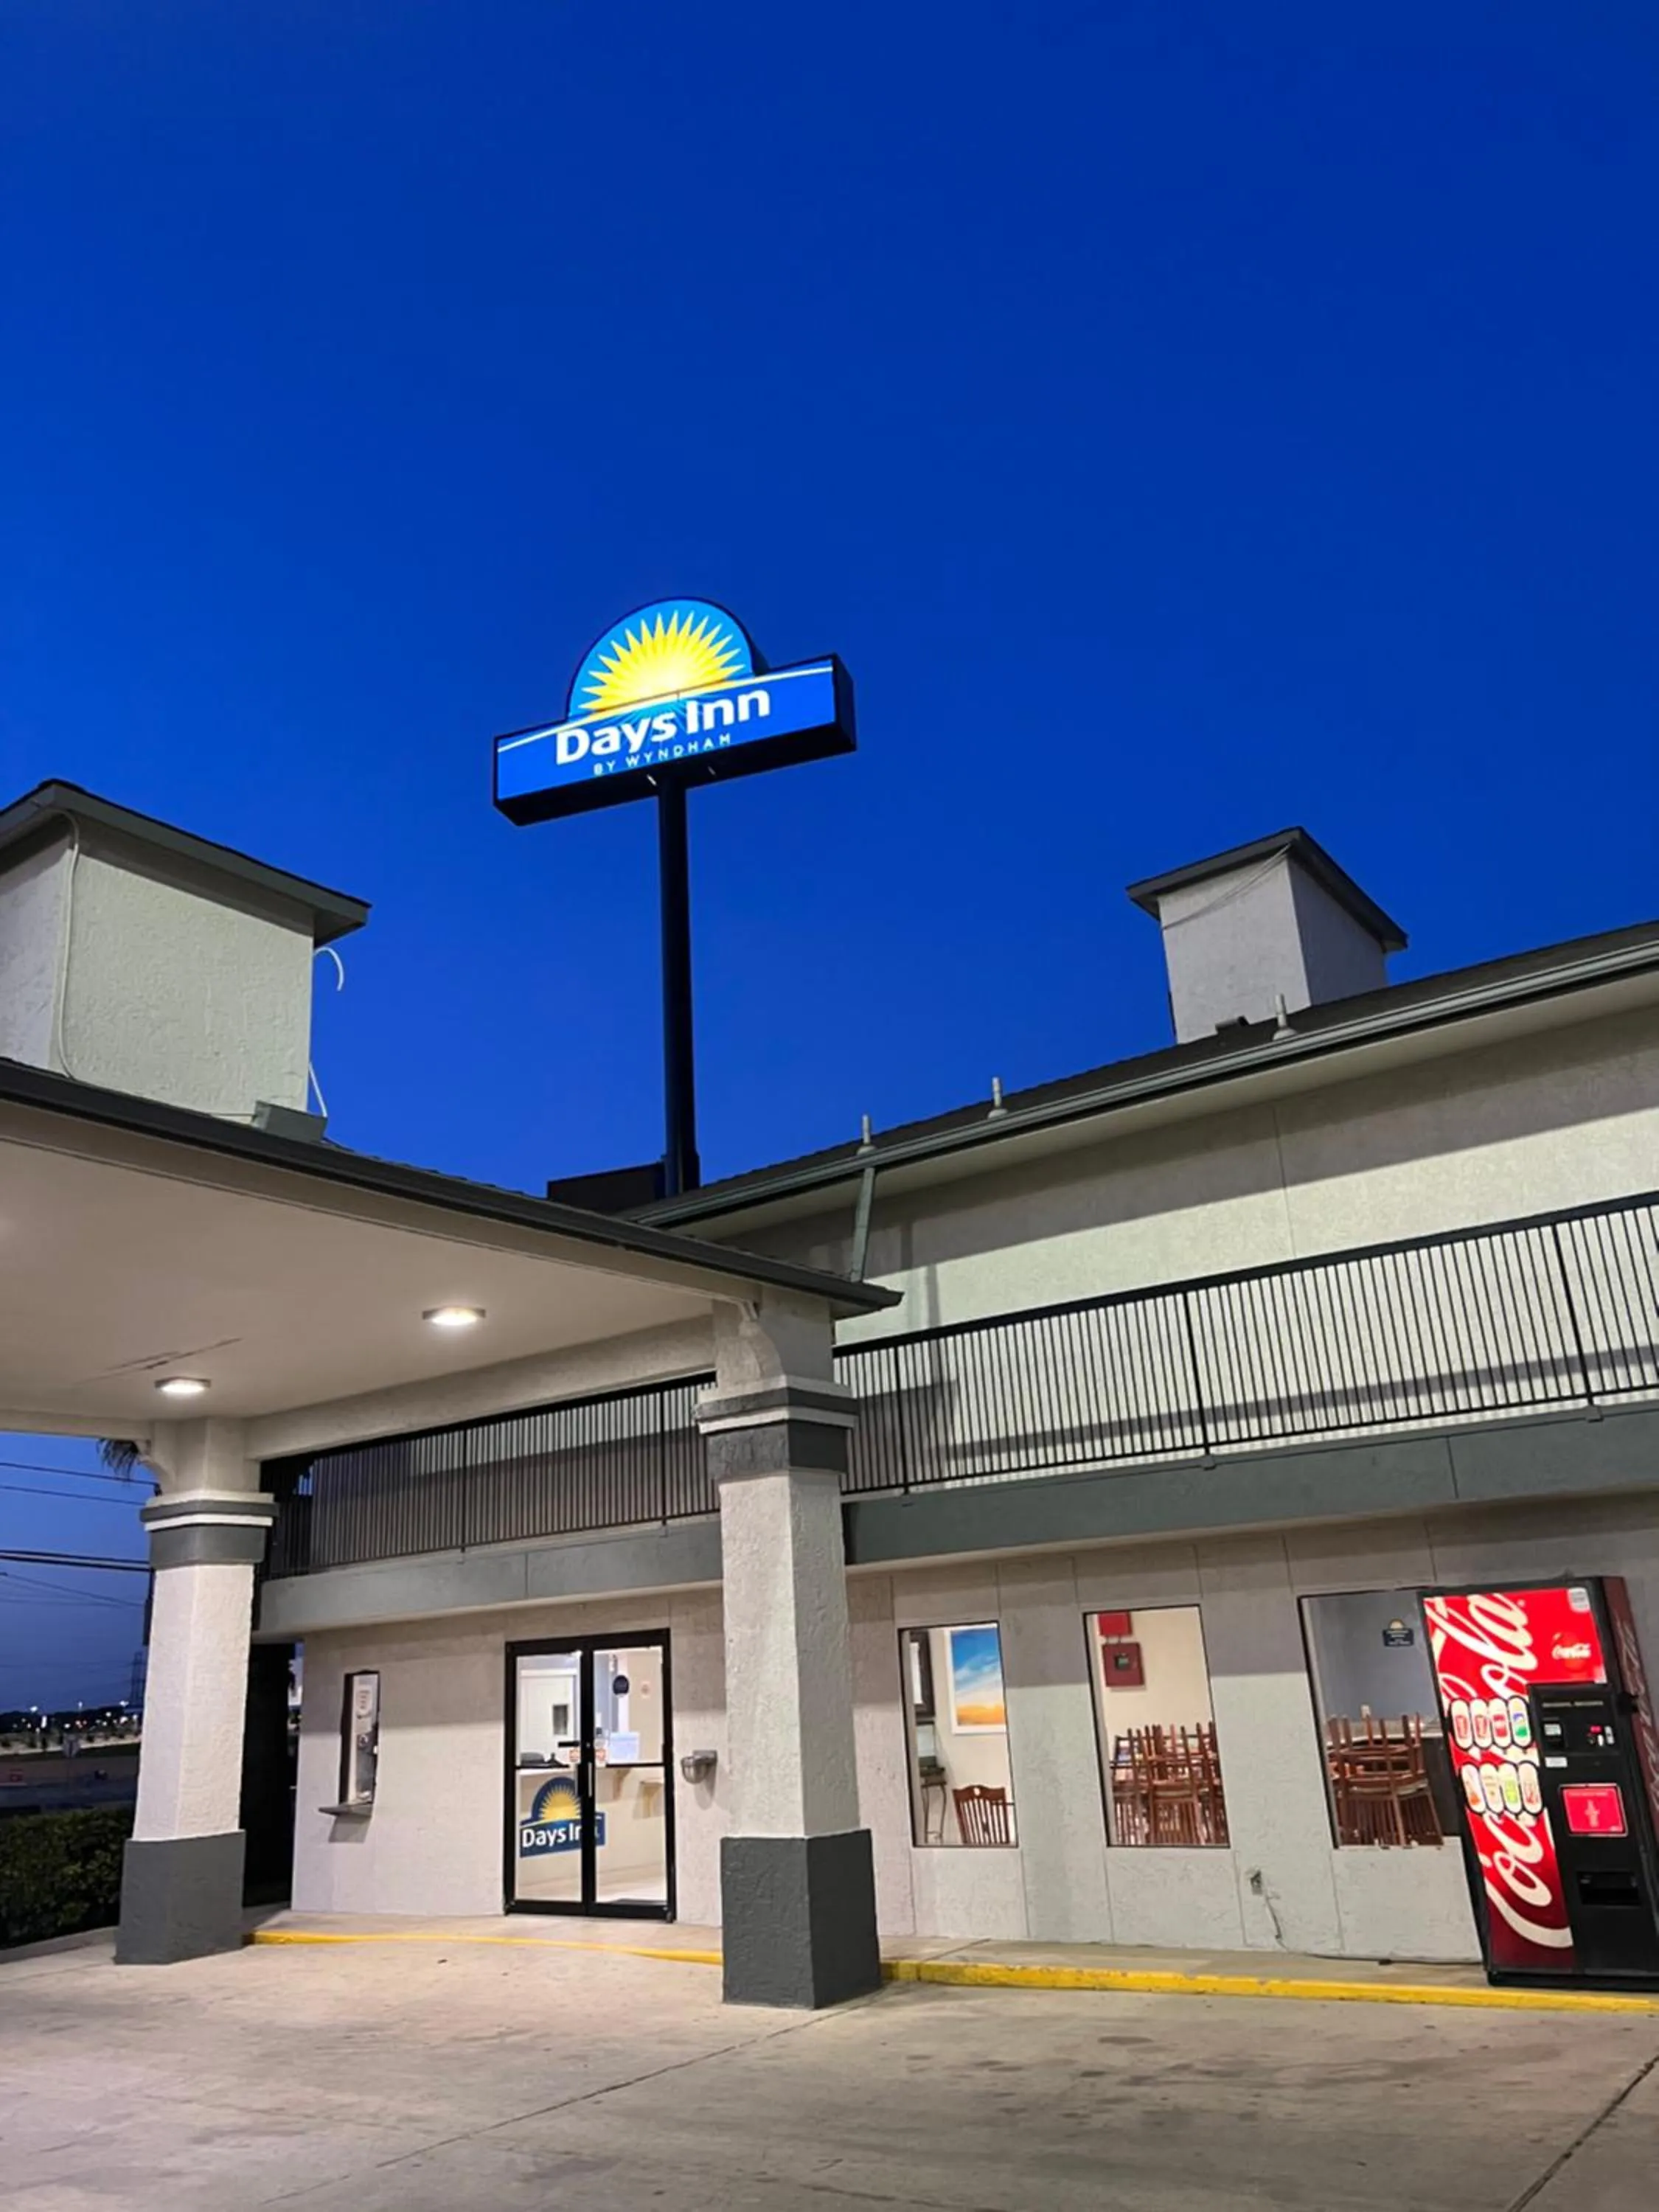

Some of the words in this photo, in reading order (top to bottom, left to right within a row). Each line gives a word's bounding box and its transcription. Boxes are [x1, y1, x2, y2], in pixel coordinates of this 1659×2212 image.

[556, 712, 678, 765] Days
[685, 689, 771, 735] Inn
[593, 760, 616, 776] BY
[626, 733, 731, 768] WYNDHAM
[1424, 1593, 1573, 1948] Cocola
[522, 1826, 566, 1848] Days
